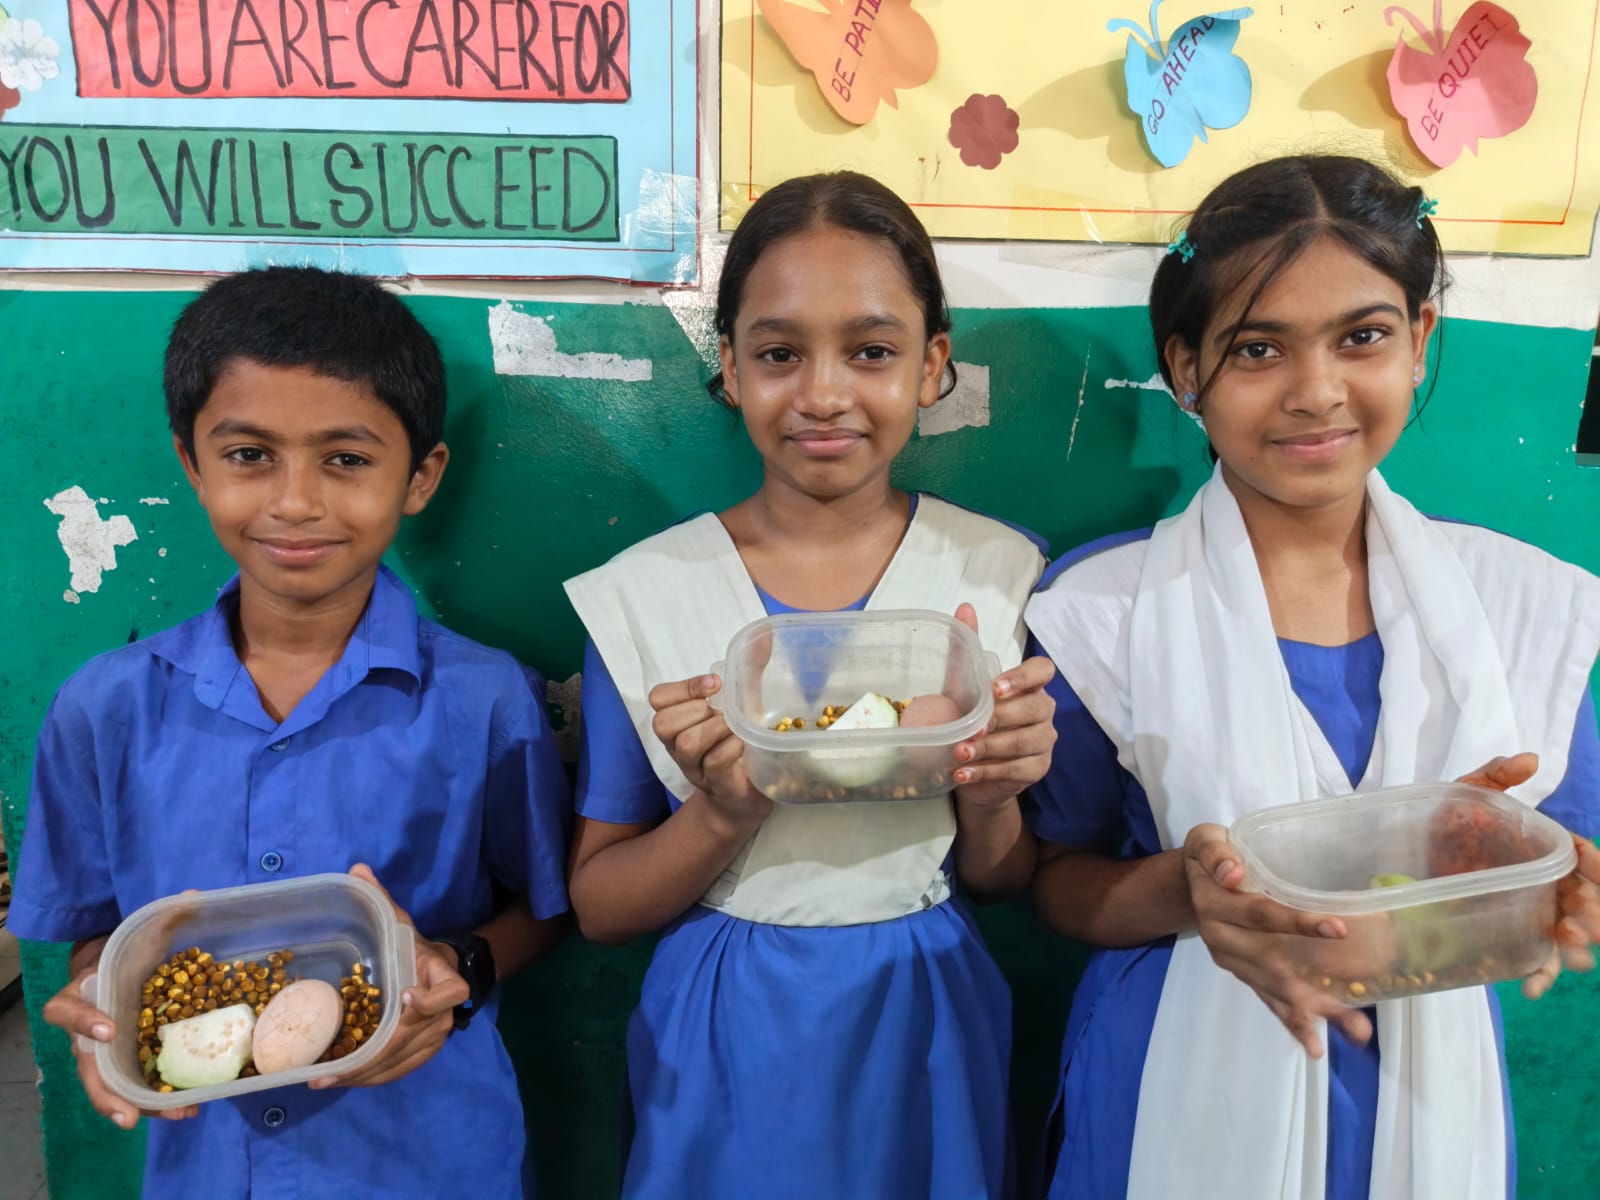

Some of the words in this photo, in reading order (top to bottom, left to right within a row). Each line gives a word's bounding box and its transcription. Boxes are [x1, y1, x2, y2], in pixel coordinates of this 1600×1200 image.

[832, 57, 856, 102] BE
[1147, 98, 1165, 136] GO
[1161, 15, 1216, 97] AHEAD
[1420, 97, 1445, 142] BE
[1438, 12, 1504, 99] QUIET
[0, 135, 116, 228] YOU
[137, 137, 322, 231] WILL
[323, 141, 611, 235] SUCCEED
